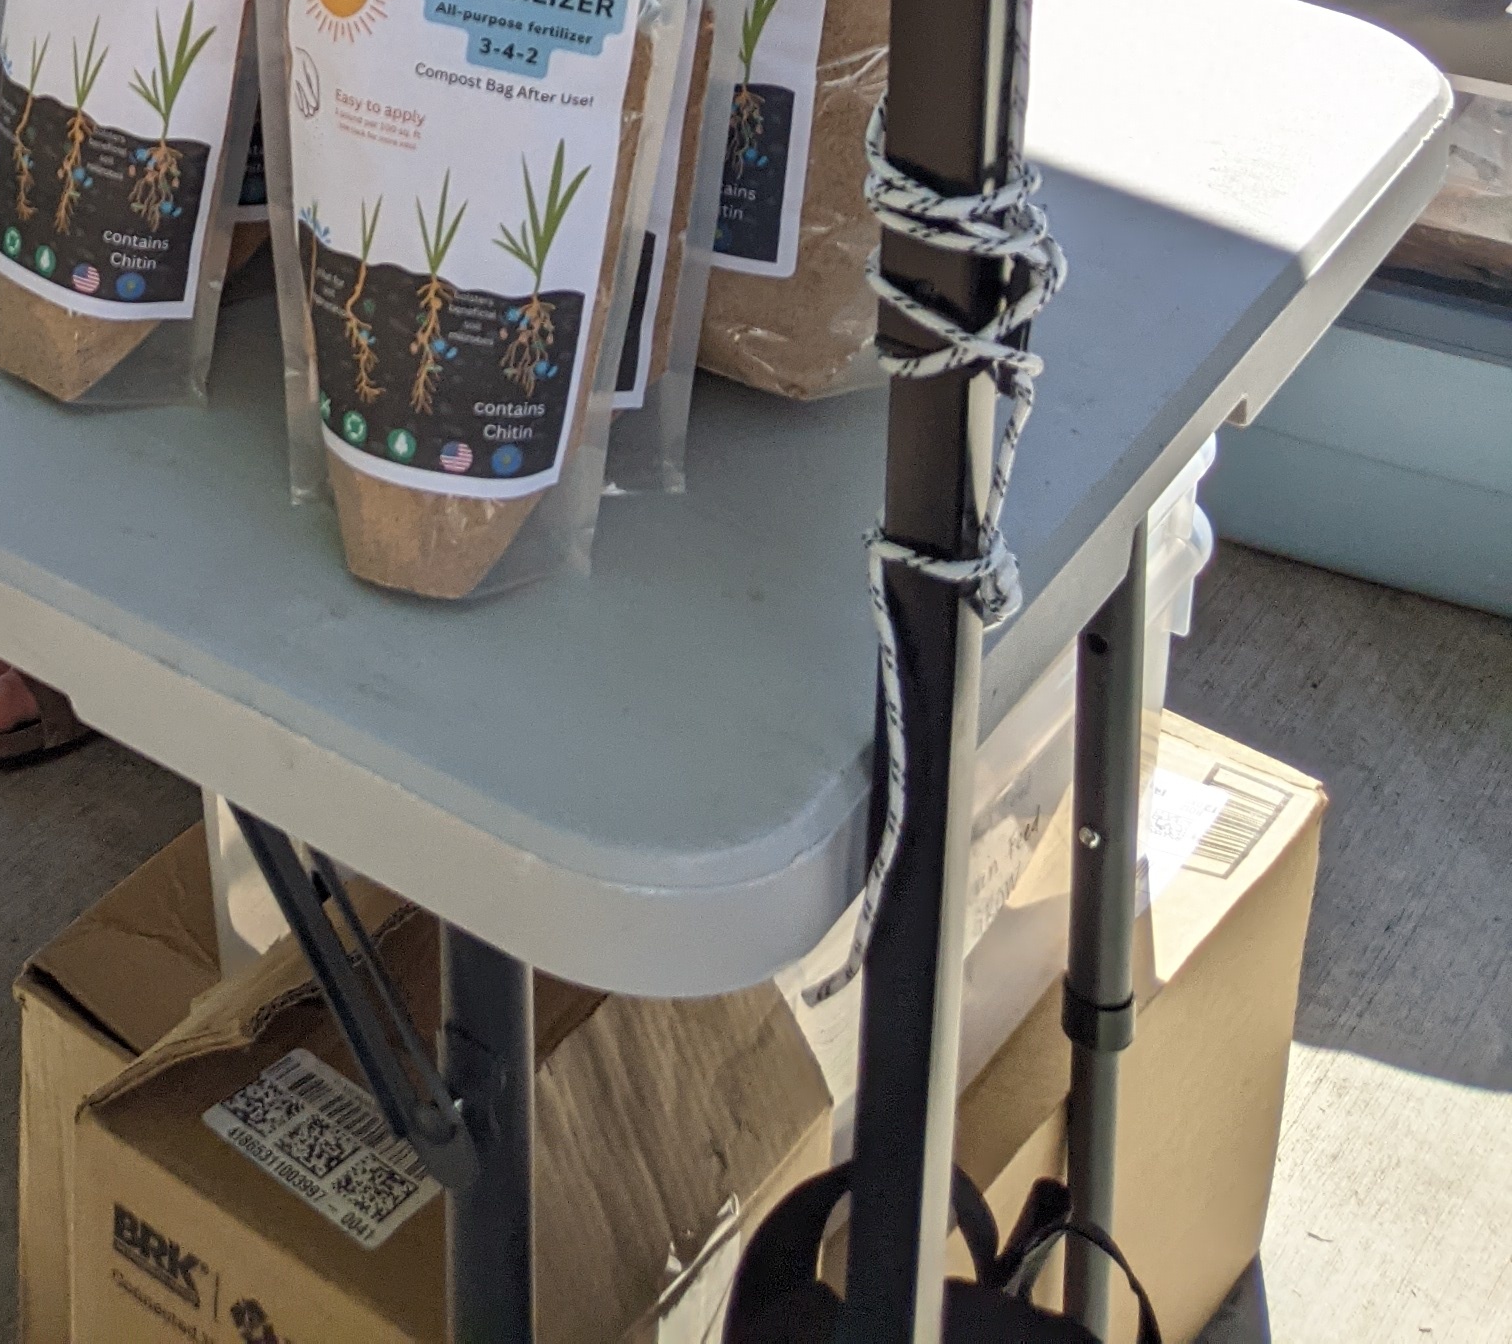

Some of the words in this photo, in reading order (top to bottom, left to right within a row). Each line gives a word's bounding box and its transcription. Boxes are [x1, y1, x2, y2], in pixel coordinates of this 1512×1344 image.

[436, 0, 523, 30] All-purpose
[528, 20, 593, 46] fertilizer
[479, 37, 539, 64] 3-4-2
[415, 61, 482, 90] Compost
[486, 78, 514, 99] Bag
[517, 85, 557, 104] After
[561, 93, 595, 107] Use!
[336, 88, 362, 111] Easy
[367, 99, 381, 113] to
[385, 105, 426, 127] apply
[103, 229, 170, 250] contains
[110, 252, 157, 270] Chitin
[473, 401, 546, 417] contains
[483, 423, 533, 440] Chitin
[113, 1202, 201, 1306] BRK
